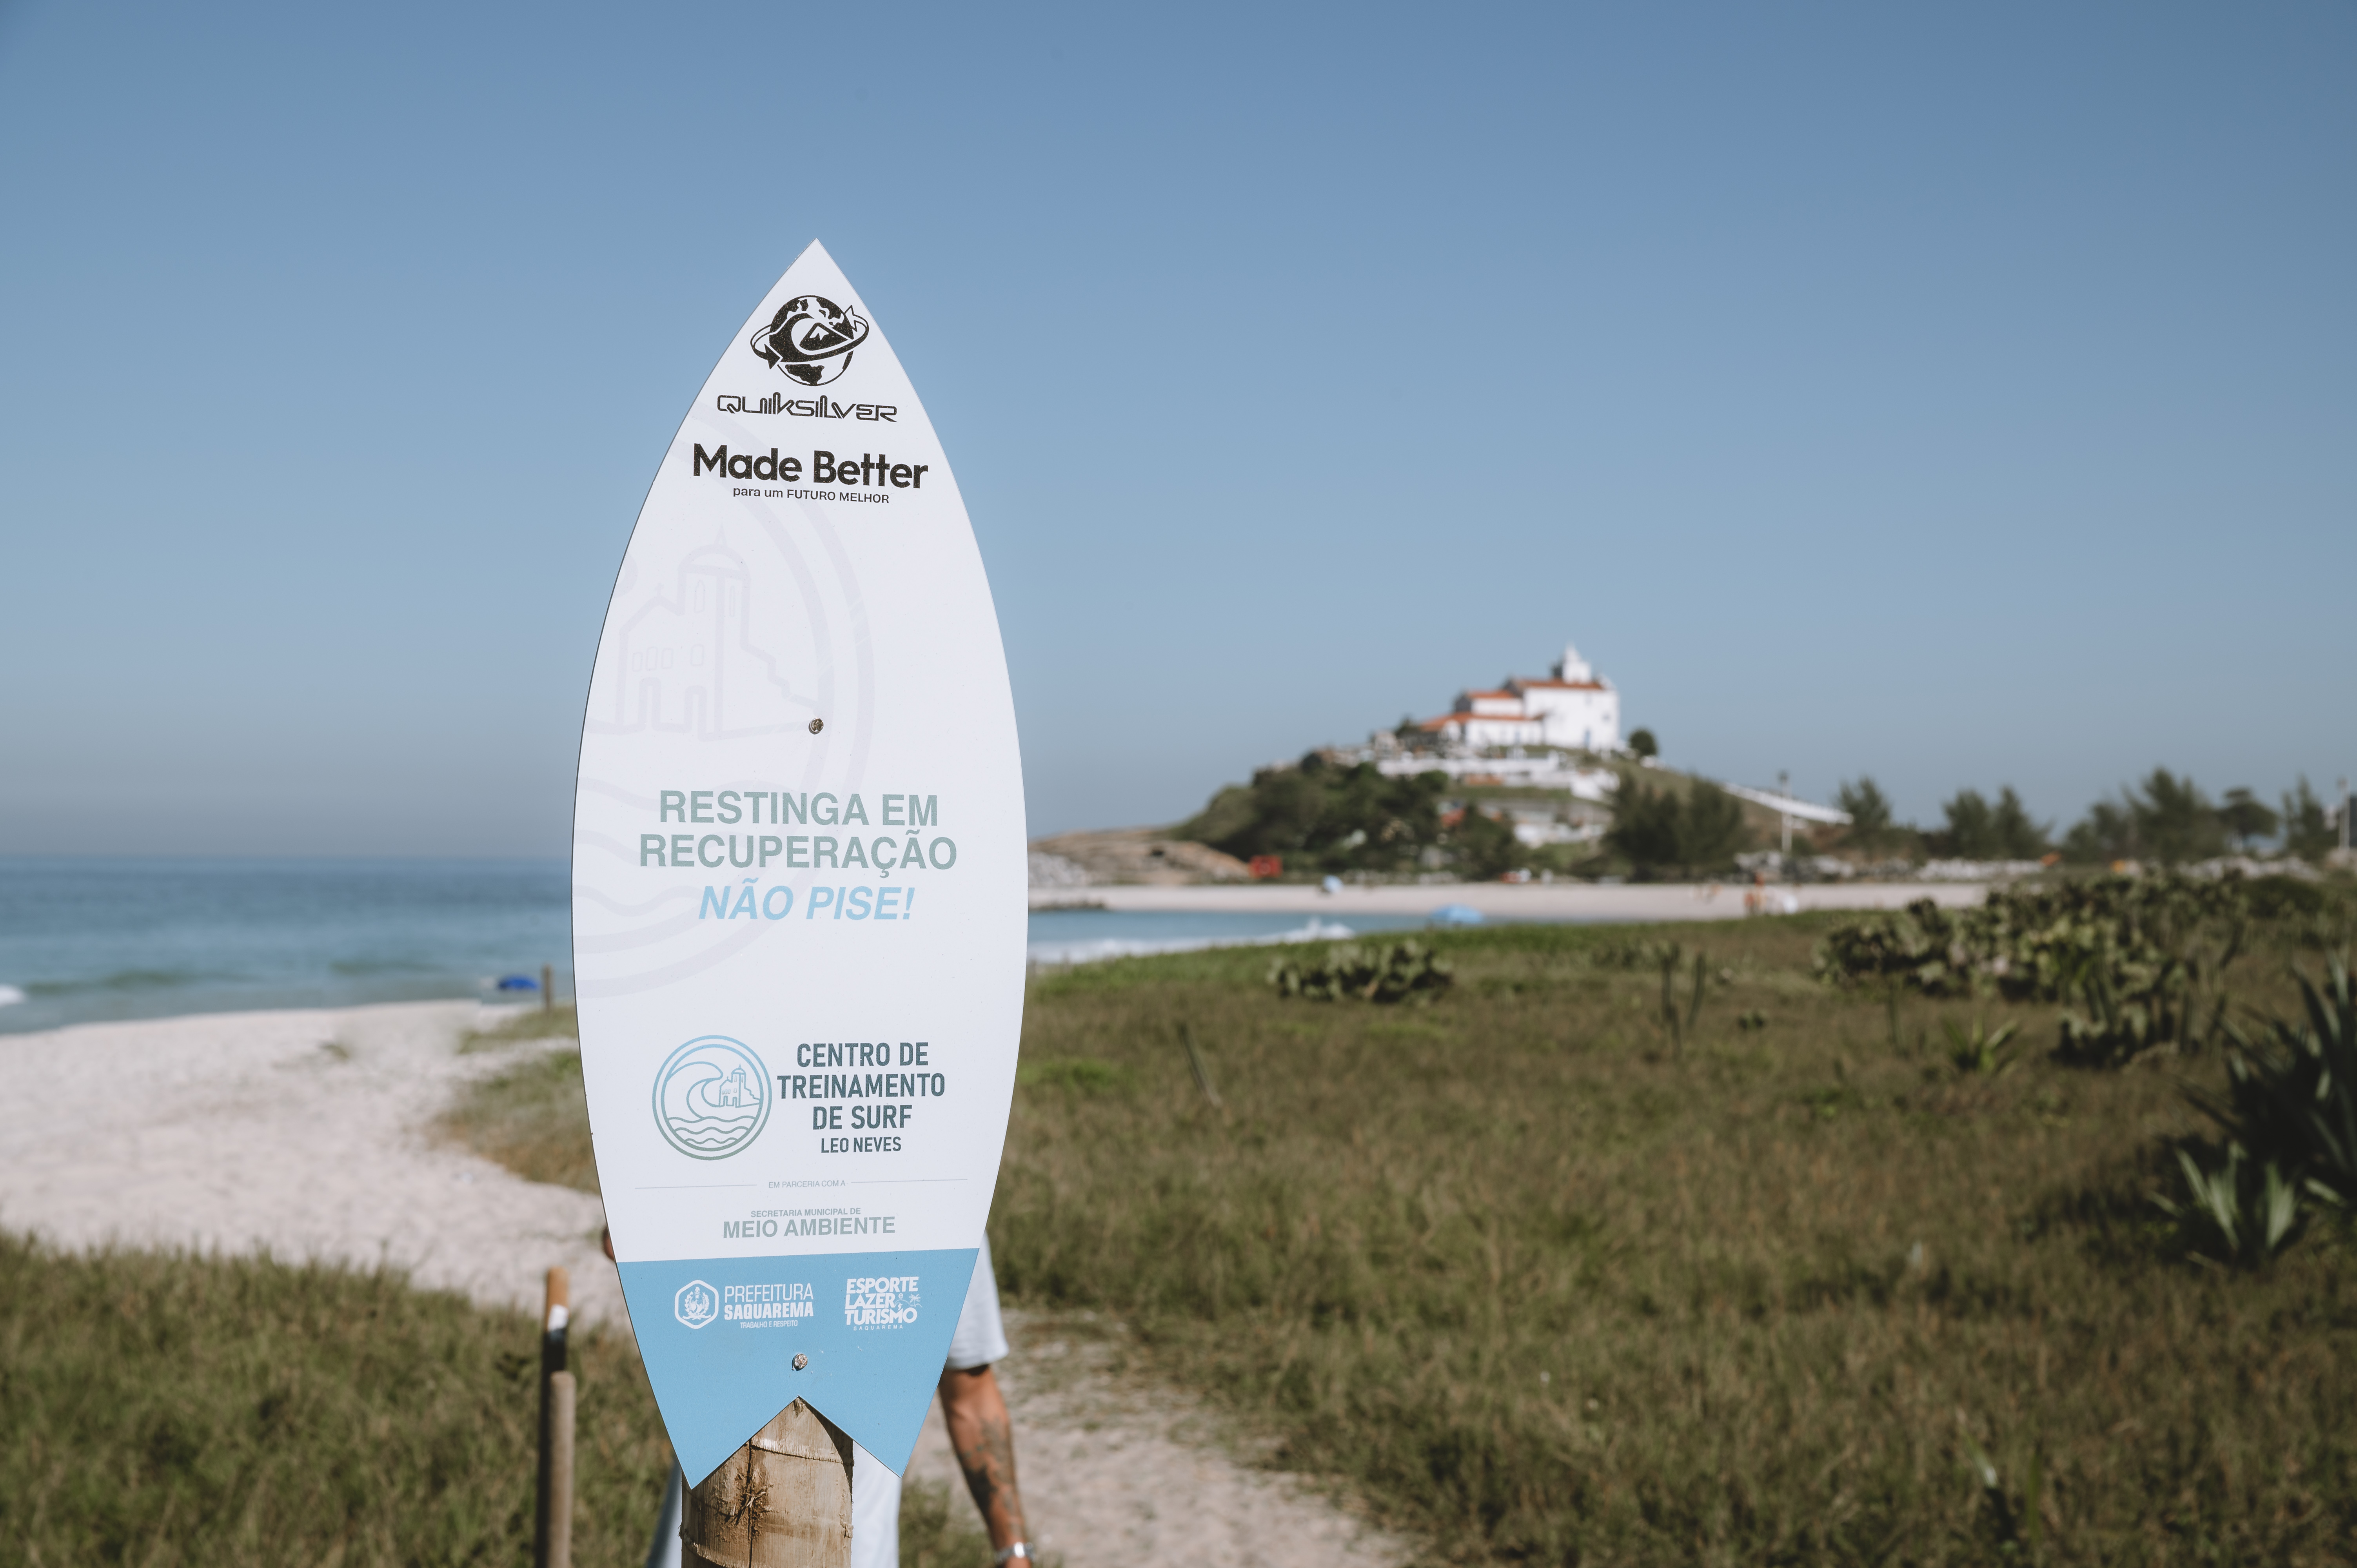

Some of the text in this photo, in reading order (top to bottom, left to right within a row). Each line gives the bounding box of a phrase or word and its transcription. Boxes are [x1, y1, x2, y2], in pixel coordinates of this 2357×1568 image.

[717, 392, 898, 423] QUIKSILVER
[694, 443, 929, 489] Made Better
[734, 488, 890, 504] para um FUTURO MELHOR
[660, 790, 937, 827] RESTINGA EM
[640, 829, 957, 878] RECUPERAÇÃO
[698, 877, 915, 920] NÃO PISE!
[797, 1042, 929, 1067] CENTRO DE
[777, 1073, 945, 1099] TREINAMENTO
[813, 1105, 913, 1130] DE SURF
[821, 1136, 902, 1154] LEO NEVES
[723, 1216, 895, 1239] MEIO AMBIENTE
[725, 1283, 814, 1303] PREFEITURA
[846, 1276, 919, 1294] ESPORTE
[724, 1301, 814, 1320] SAQUAREMA
[845, 1292, 895, 1310] LAZER
[844, 1307, 918, 1325] TURISMO
